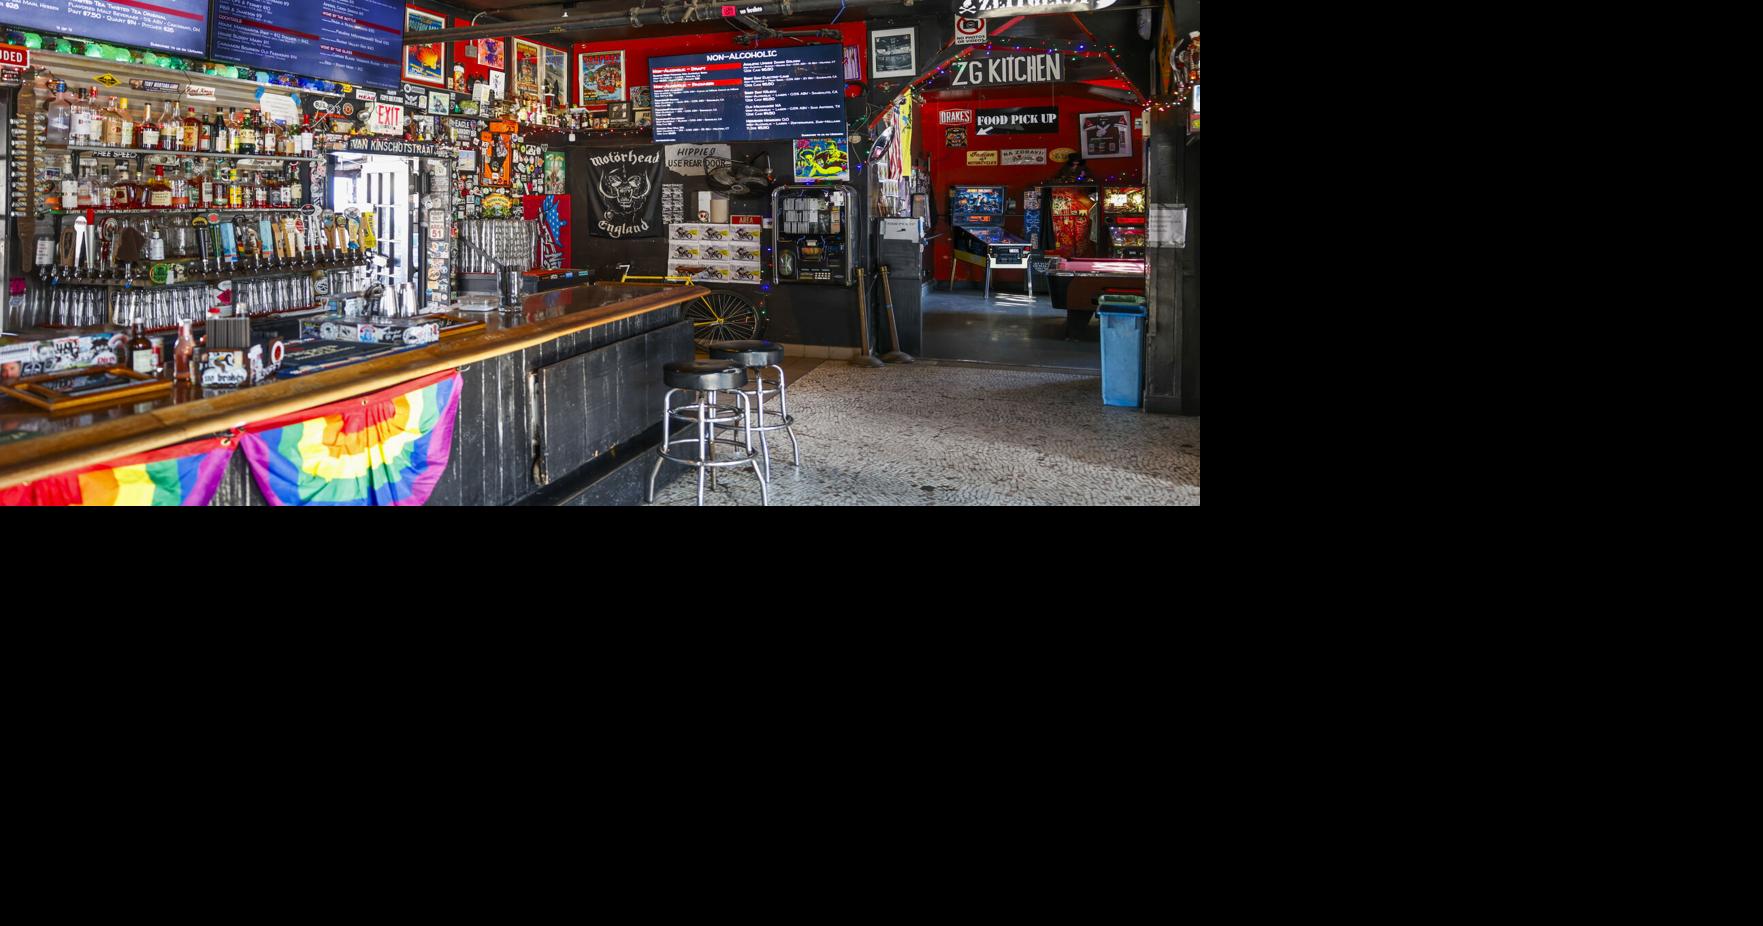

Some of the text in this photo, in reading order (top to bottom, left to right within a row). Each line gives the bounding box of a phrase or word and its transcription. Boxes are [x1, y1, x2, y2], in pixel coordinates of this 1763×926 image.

[706, 50, 777, 61] NON-ALCOHOLIC
[952, 54, 1060, 85] ZG KITCHEN
[377, 105, 400, 125] EXIT
[977, 114, 1056, 126] FOOD PICK UP
[352, 138, 368, 150] VAN
